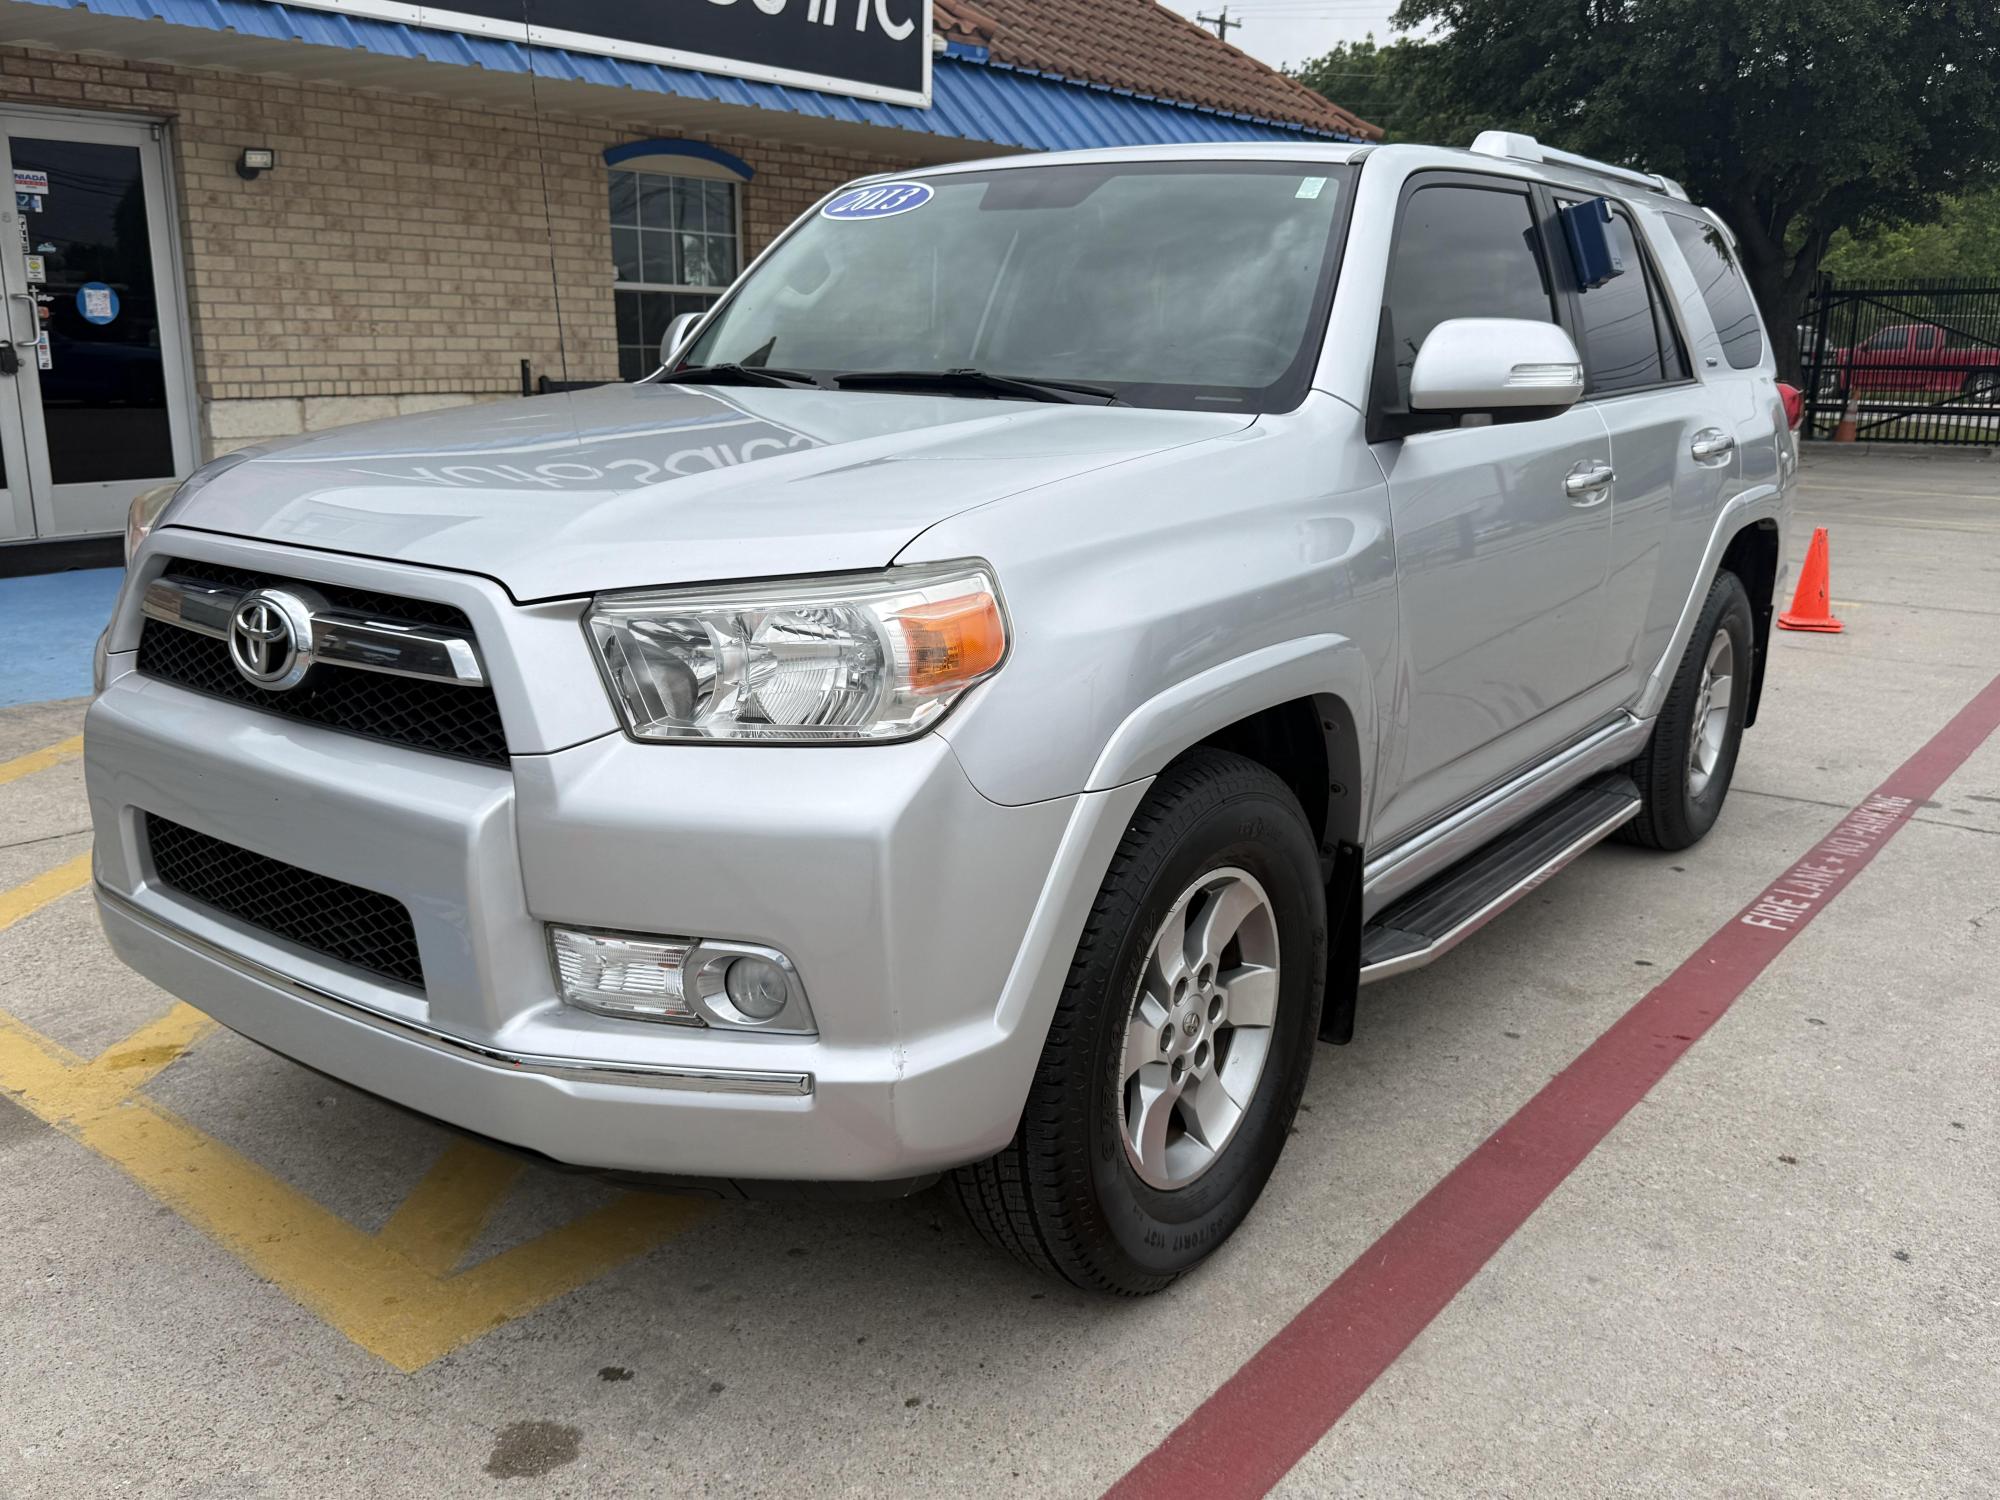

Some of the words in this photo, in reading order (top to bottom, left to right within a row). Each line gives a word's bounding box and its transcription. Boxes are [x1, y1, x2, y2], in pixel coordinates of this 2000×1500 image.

[831, 187, 920, 212] 2013
[1819, 837, 1870, 857] NO
[1774, 863, 1845, 899] LANE
[1741, 895, 1811, 931] FIRE
